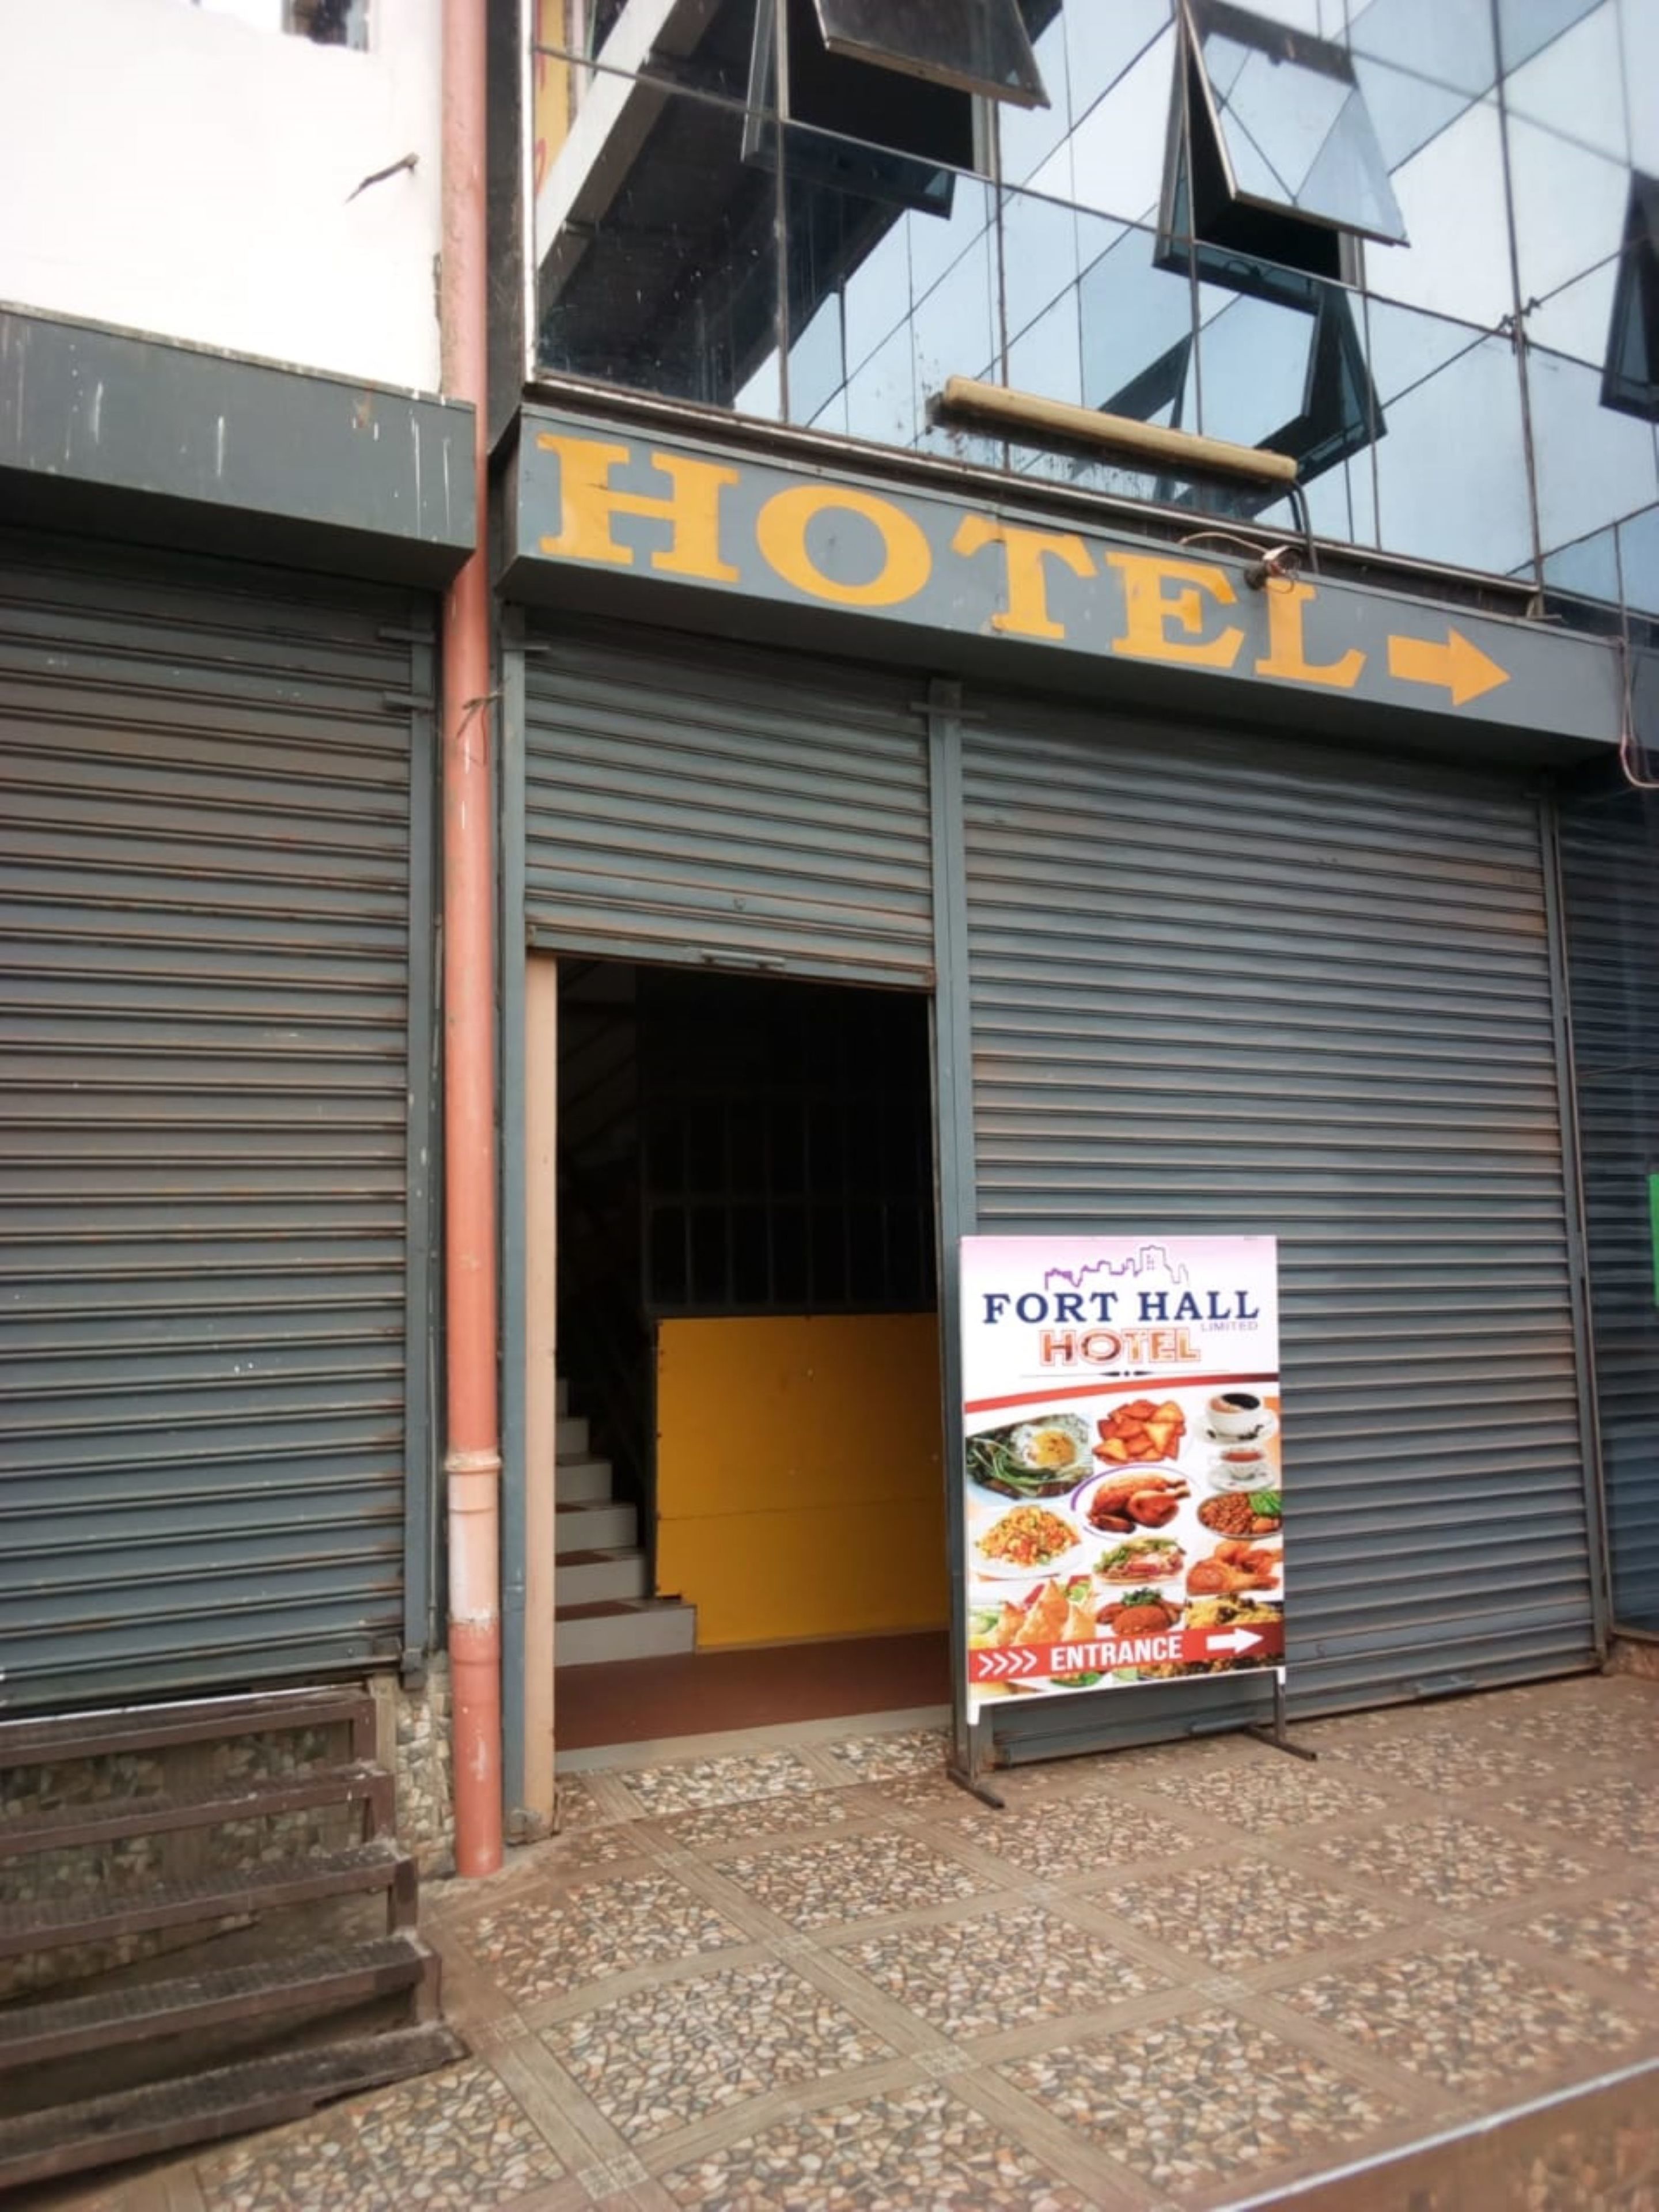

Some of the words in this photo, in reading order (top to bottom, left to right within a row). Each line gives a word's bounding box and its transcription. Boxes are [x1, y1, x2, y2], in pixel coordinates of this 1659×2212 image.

[535, 433, 1367, 688] HOTEL
[983, 1292, 1119, 1324] FORT
[1138, 1290, 1259, 1322] HALL
[1200, 1321, 1258, 1332] LIMITED
[1040, 1327, 1201, 1366] HOTEL
[1051, 1635, 1183, 1672] ENTRANCE
